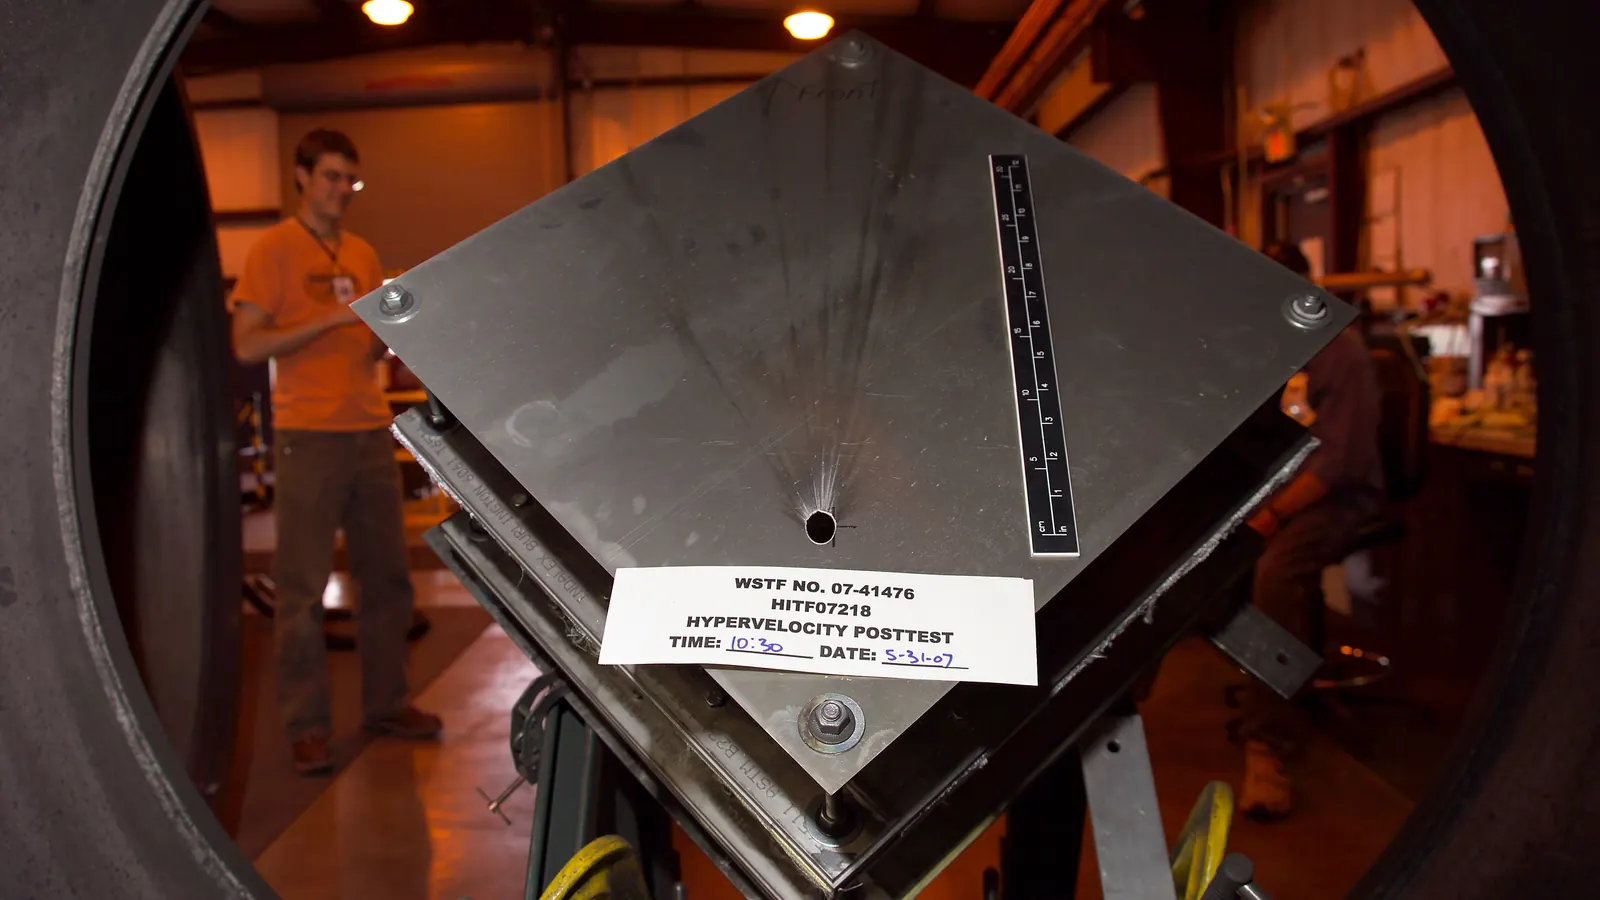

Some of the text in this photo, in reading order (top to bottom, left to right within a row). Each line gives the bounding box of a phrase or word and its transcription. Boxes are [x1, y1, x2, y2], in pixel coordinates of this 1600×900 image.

[1008, 266, 1016, 274] 20
[473, 485, 541, 552] BURLINGTON
[1038, 521, 1046, 532] cm
[735, 577, 915, 600] WSTF NO. 07-41476
[771, 598, 871, 617] HITF07218
[686, 616, 954, 644] HYPERVELOCITY POSTTEST
[669, 636, 954, 668] TIME: 10:30 DATE: 5-31-07
